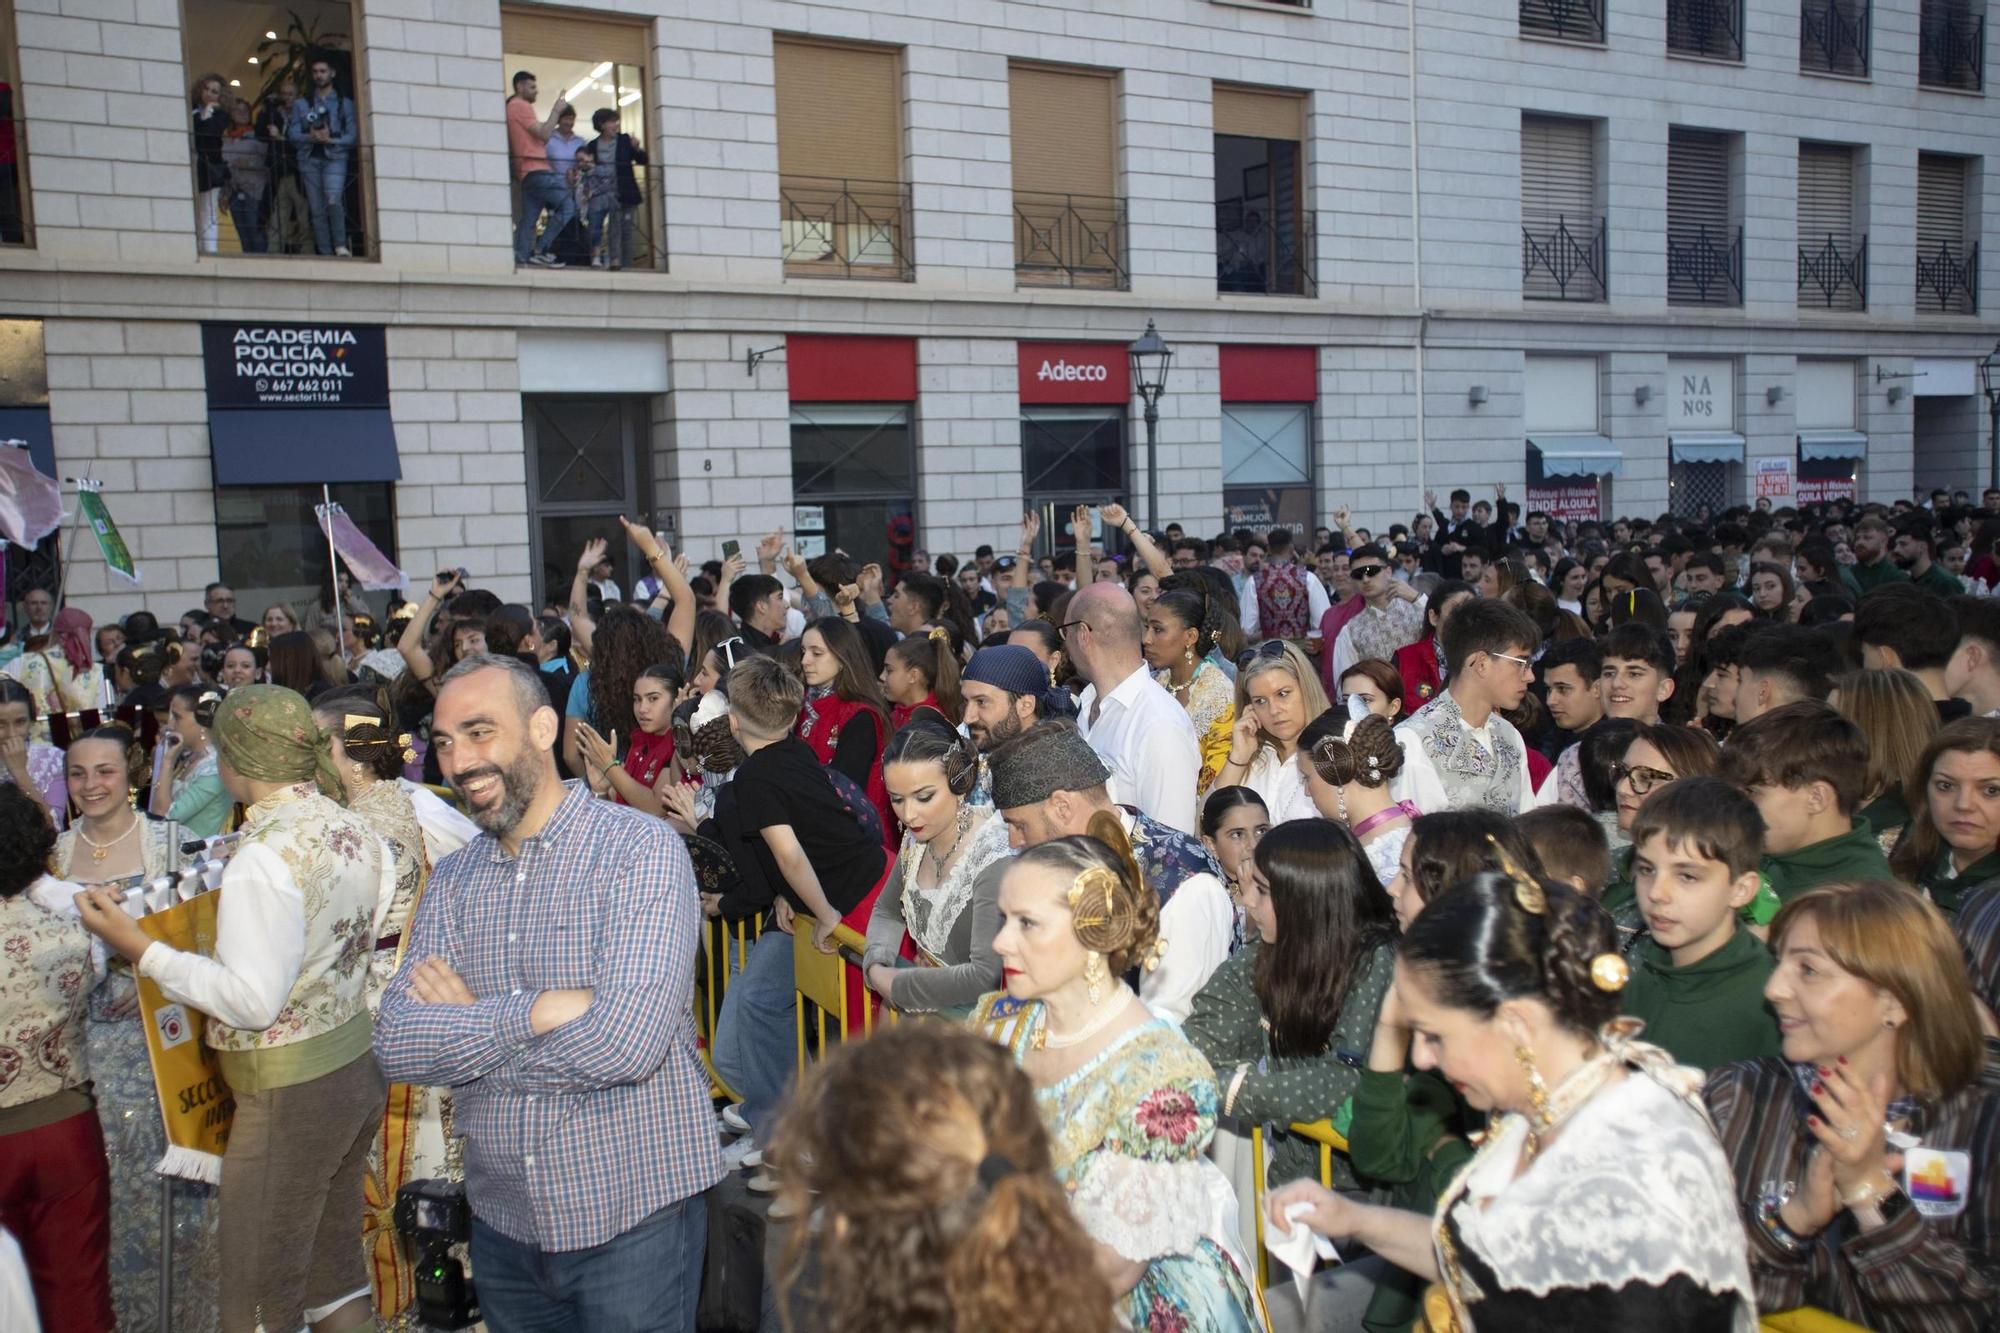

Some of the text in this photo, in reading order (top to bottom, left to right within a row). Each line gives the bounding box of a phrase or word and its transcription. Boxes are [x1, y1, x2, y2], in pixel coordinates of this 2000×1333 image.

[233, 329, 357, 345] ACADEMIA
[235, 343, 326, 361] POLICÍA
[236, 362, 354, 377] NACIONAL
[1037, 360, 1107, 381] Adecco
[272, 380, 343, 392] 667 662 011
[703, 459, 712, 472] 8
[1559, 498, 1597, 509] ALQUILA
[1243, 512, 1271, 522] MEJOR
